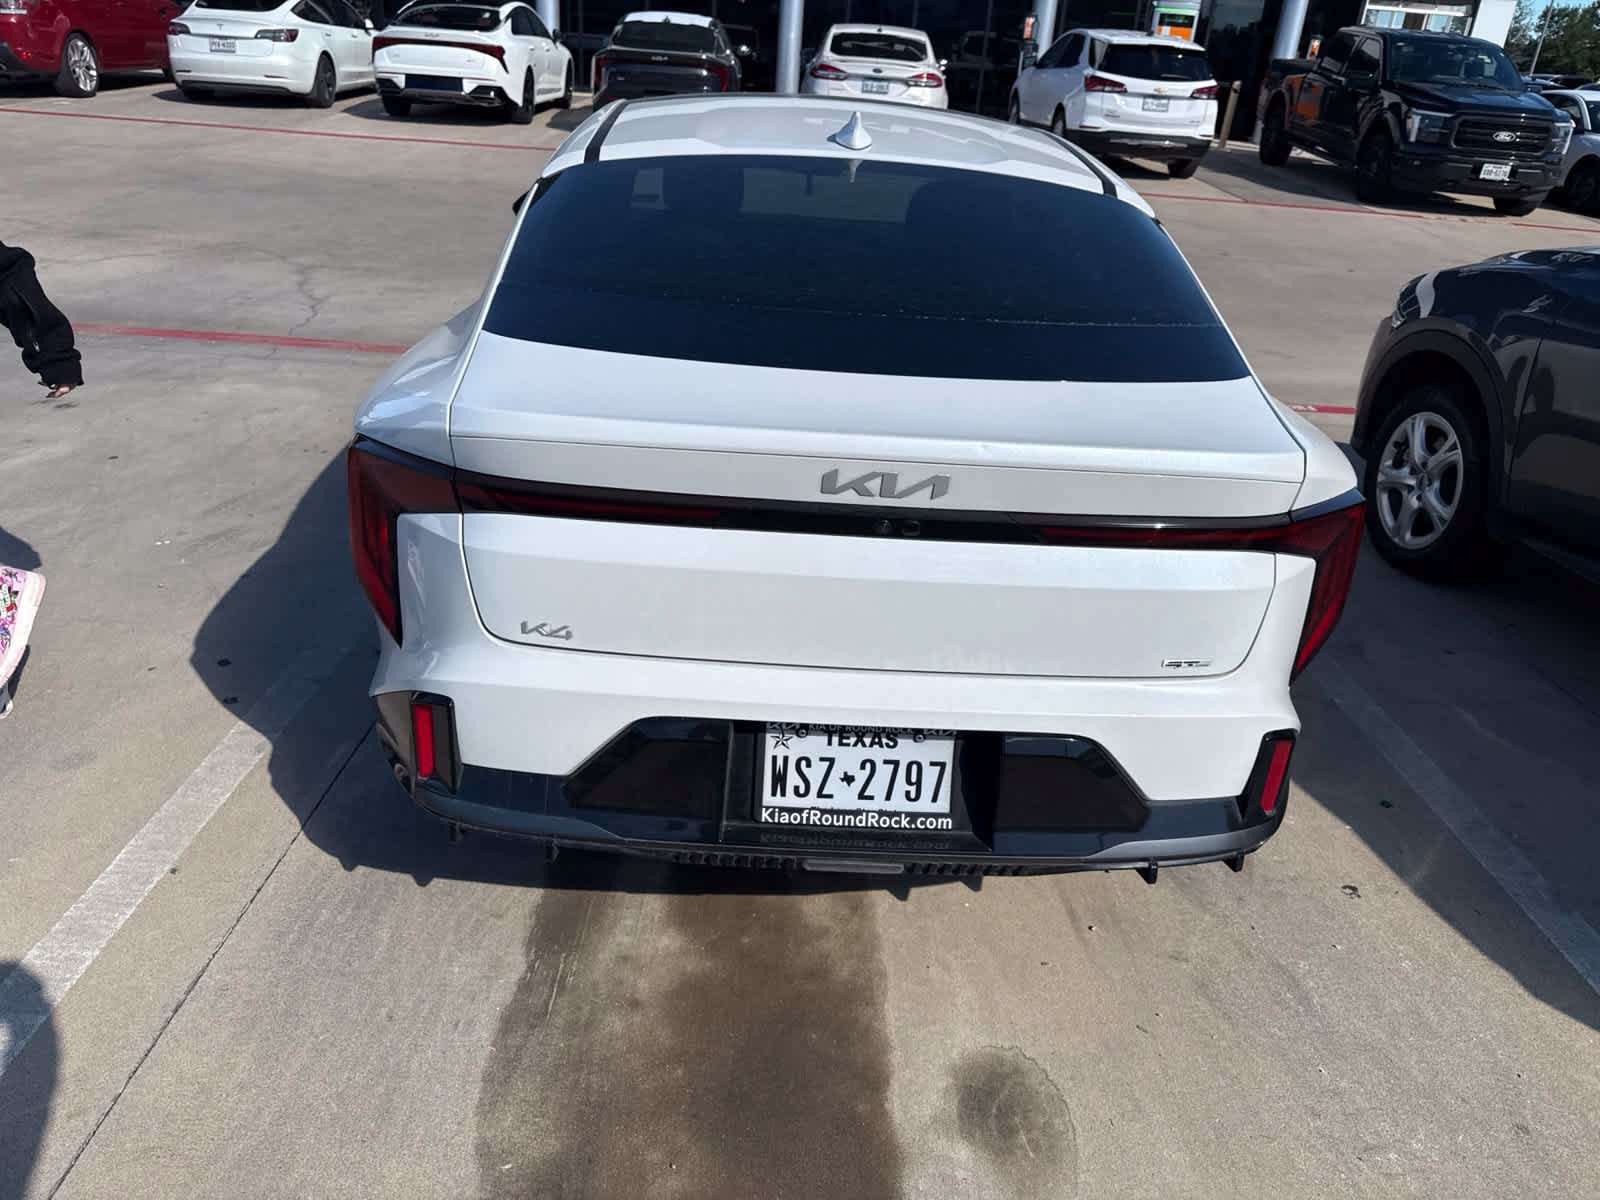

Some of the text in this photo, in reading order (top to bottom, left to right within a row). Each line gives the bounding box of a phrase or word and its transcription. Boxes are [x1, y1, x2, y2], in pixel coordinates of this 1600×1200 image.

[821, 469, 950, 500] KIA
[521, 621, 573, 640] K4
[825, 731, 899, 749] TEXAS
[770, 754, 947, 803] WSZ 2797
[761, 807, 953, 830] KiaofRoundRock.com
